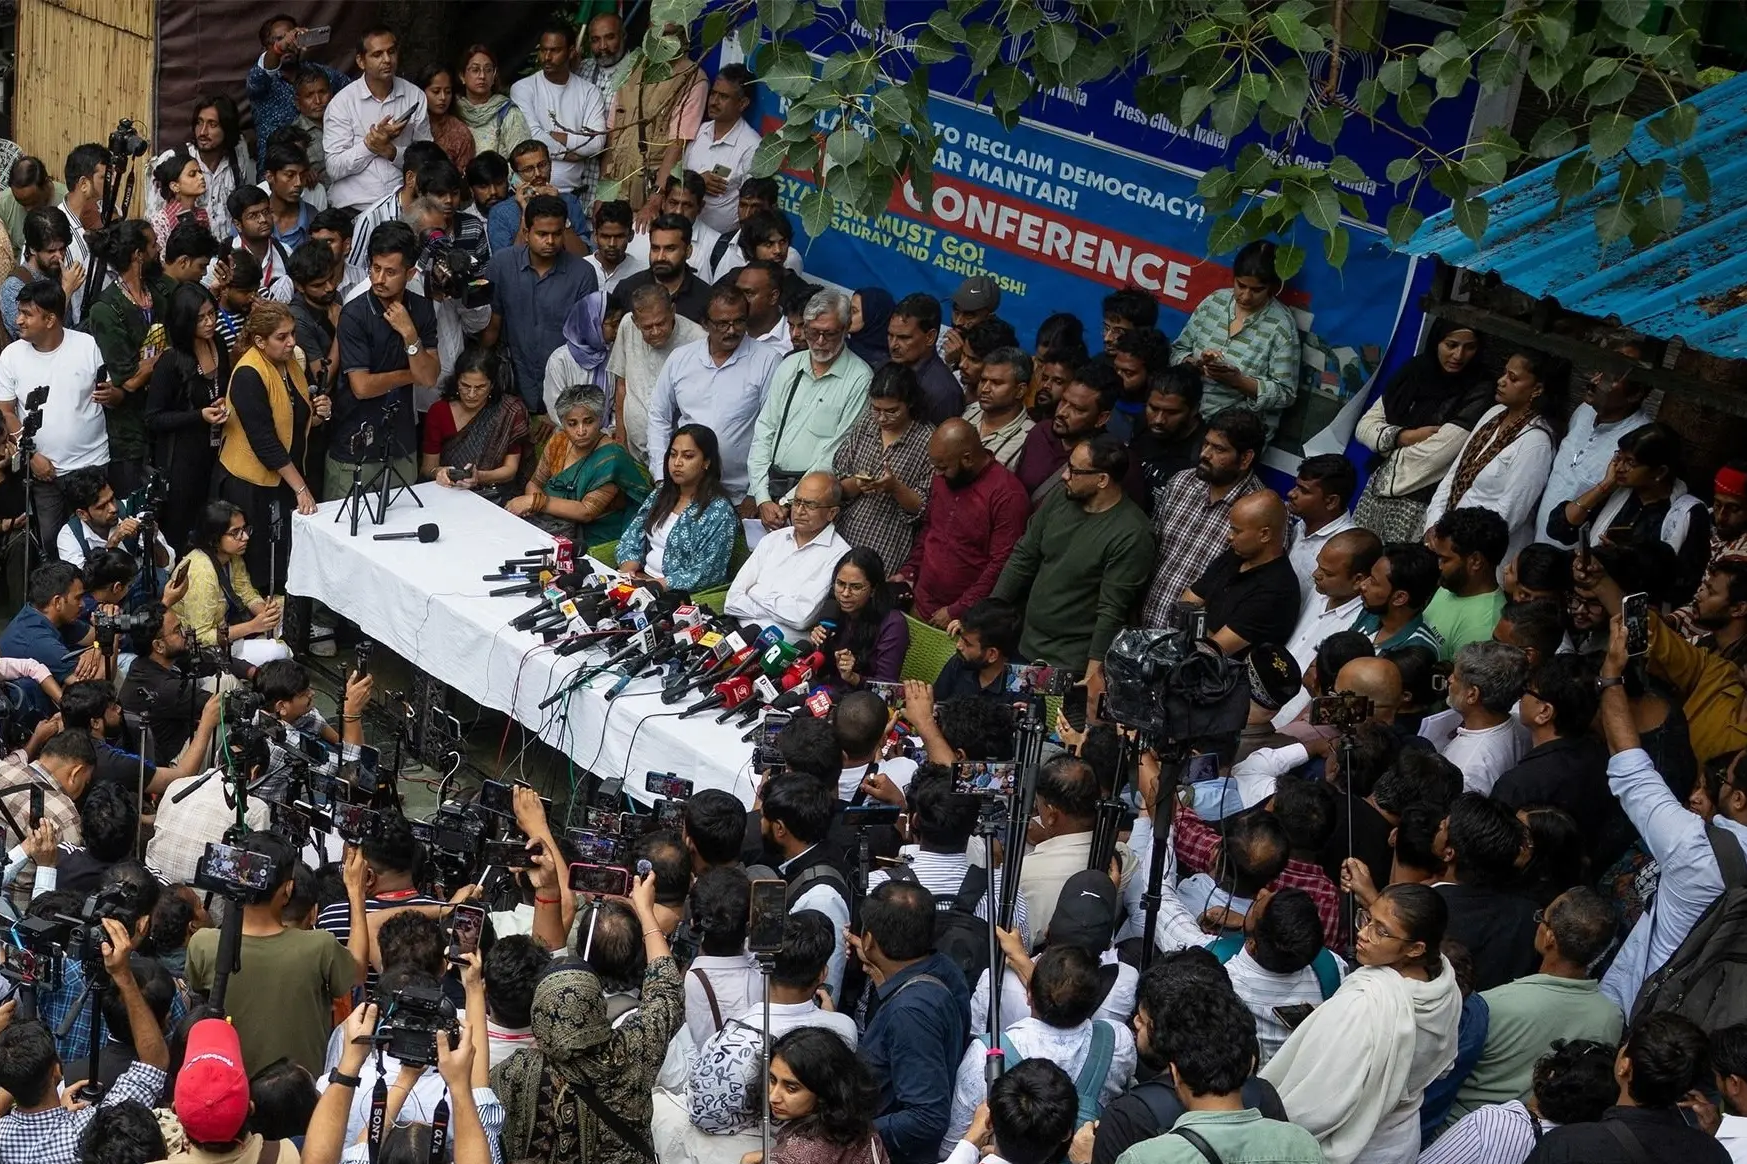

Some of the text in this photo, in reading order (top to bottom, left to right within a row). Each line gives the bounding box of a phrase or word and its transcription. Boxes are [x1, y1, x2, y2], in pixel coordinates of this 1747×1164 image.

[1113, 99, 1147, 126] Press
[1193, 124, 1227, 151] India
[933, 121, 960, 144] TO
[965, 132, 1054, 175] RECLAIM
[1059, 161, 1206, 224] DEMOCRACY!
[968, 158, 1079, 211] MANTAR!
[830, 215, 893, 248] SAURAV
[895, 242, 930, 263] AND
[875, 212, 937, 248] MUST
[940, 235, 986, 266] GO!
[644, 632, 656, 653] ANI
[372, 1106, 383, 1145] SONY
